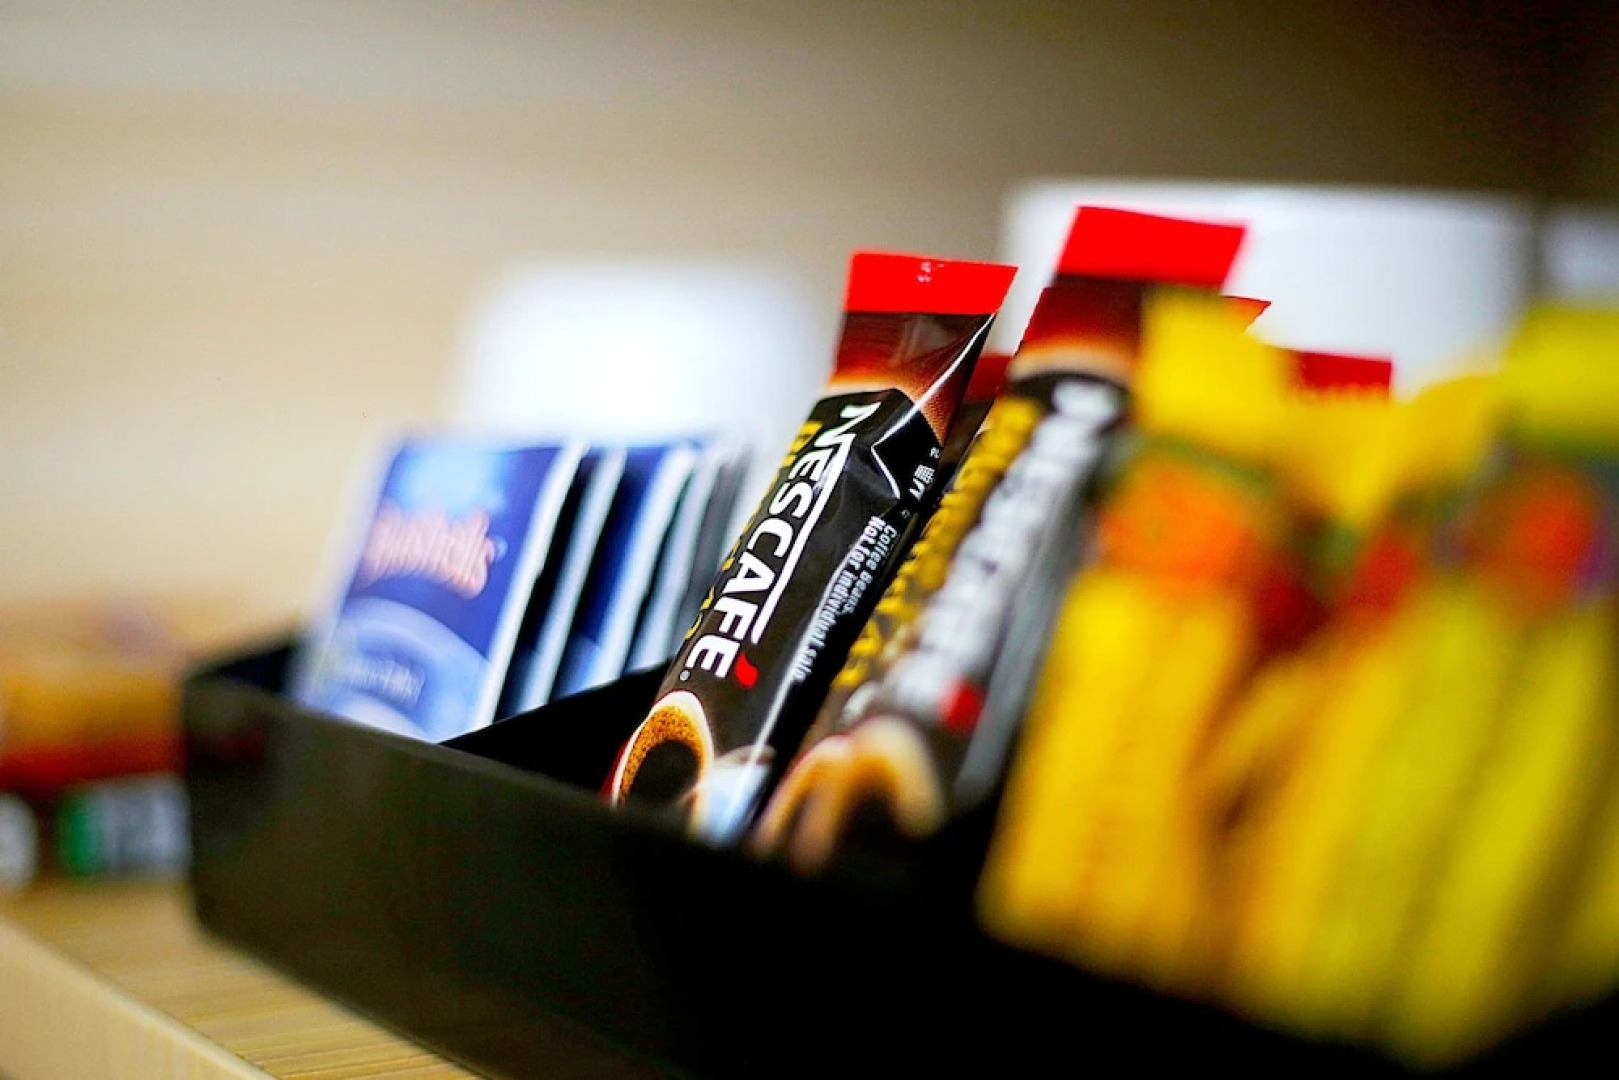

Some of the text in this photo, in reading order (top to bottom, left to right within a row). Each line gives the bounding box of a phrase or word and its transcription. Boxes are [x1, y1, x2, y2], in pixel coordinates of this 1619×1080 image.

[863, 515, 886, 545] Not
[866, 524, 898, 571] Coffee
[848, 544, 872, 571] for
[810, 569, 858, 647] individual
